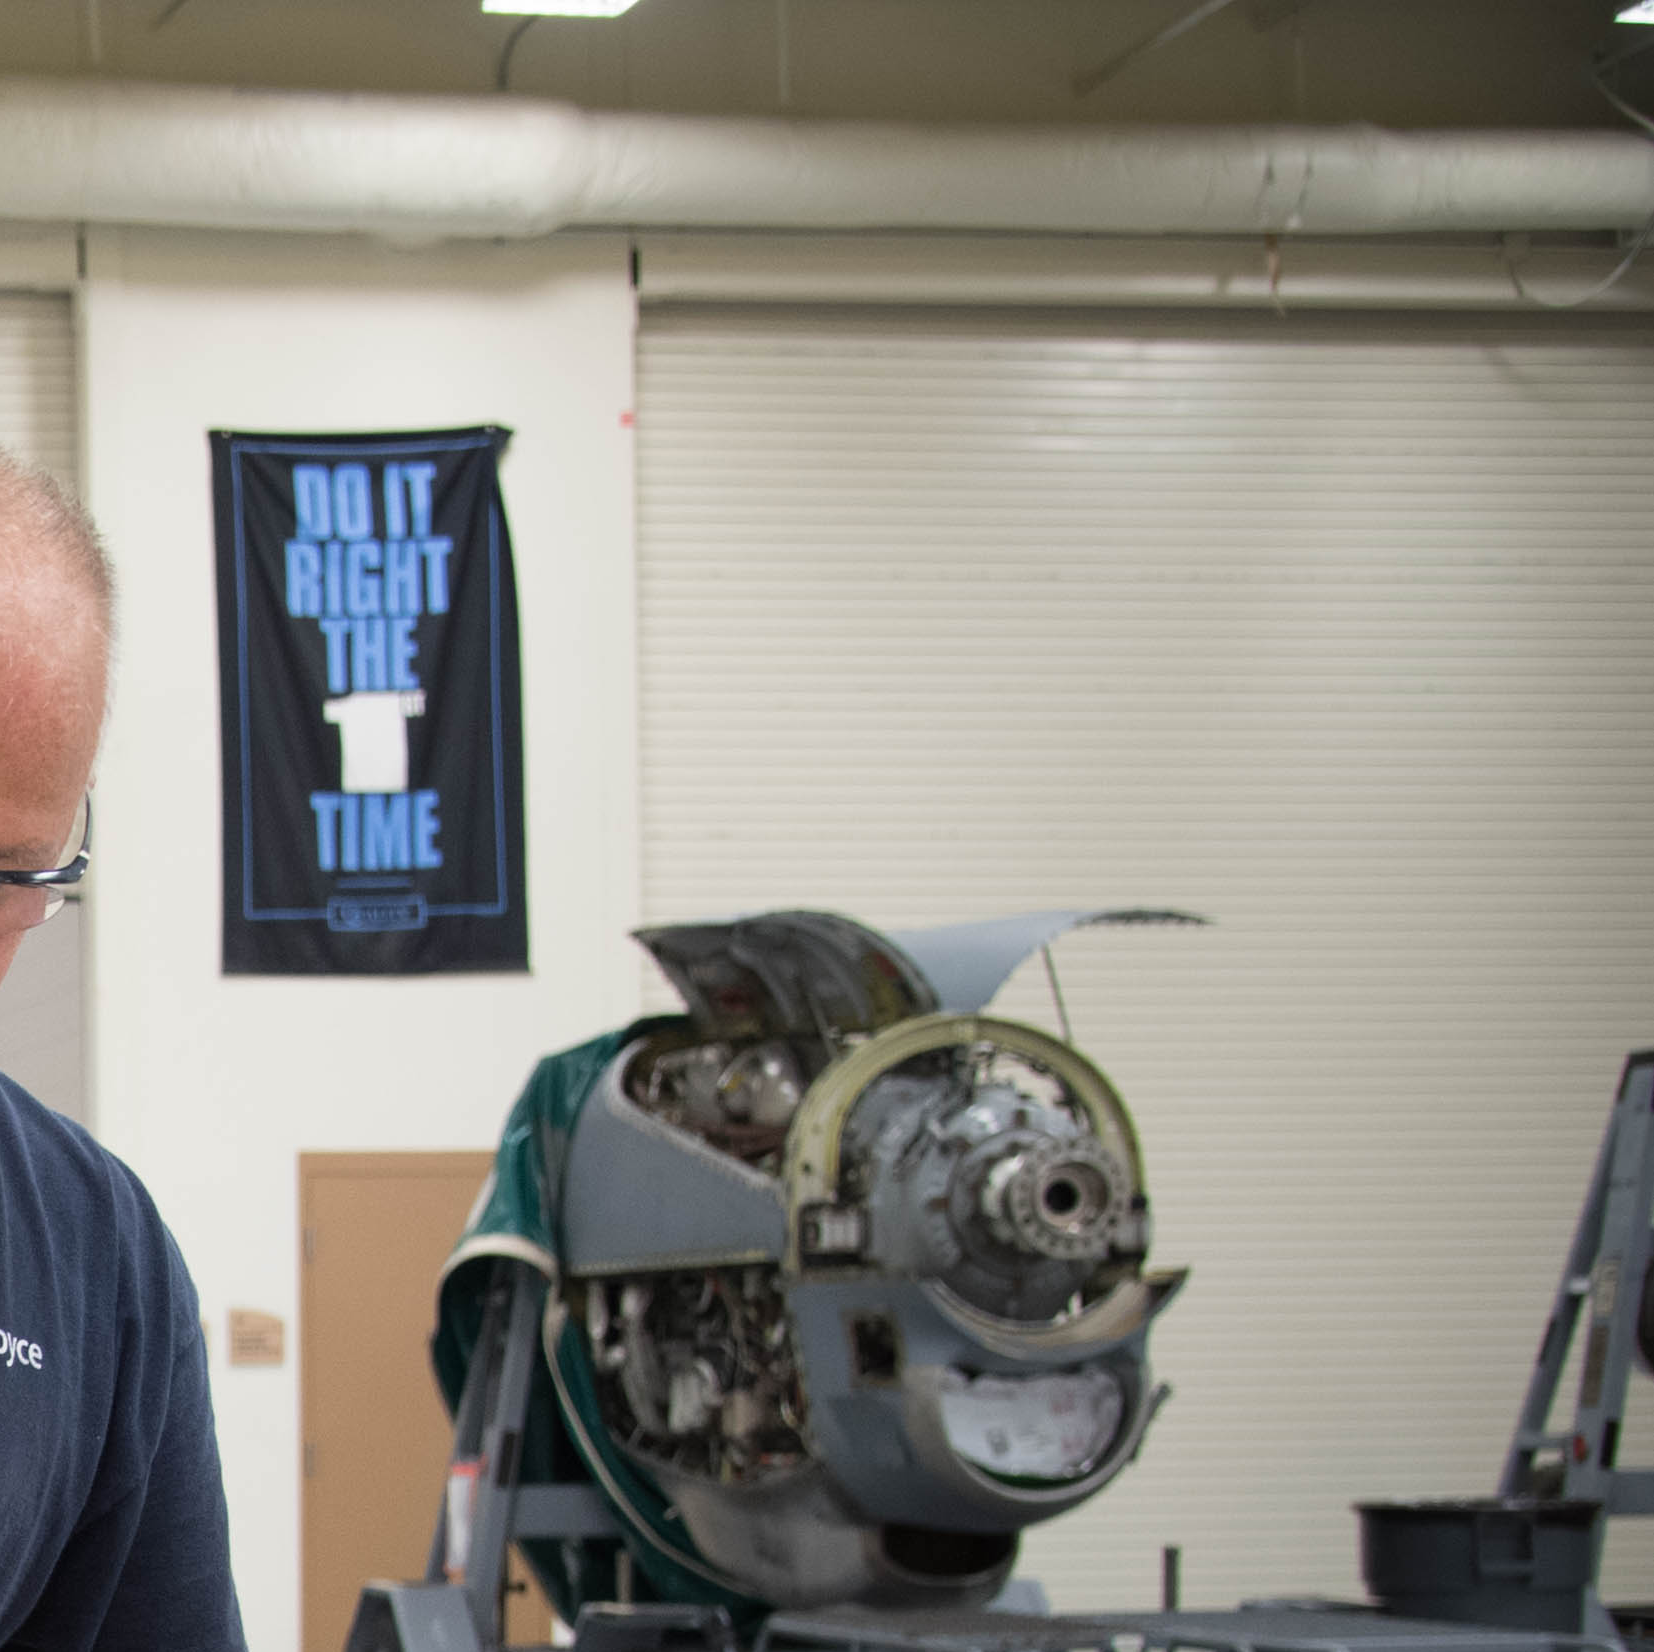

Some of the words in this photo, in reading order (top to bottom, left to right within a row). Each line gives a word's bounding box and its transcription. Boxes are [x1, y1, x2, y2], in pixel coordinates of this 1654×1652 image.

[294, 463, 373, 539] DO
[383, 461, 437, 538] IT
[285, 537, 452, 618] RIGHT
[319, 616, 420, 693] THE
[310, 790, 443, 871] TIME
